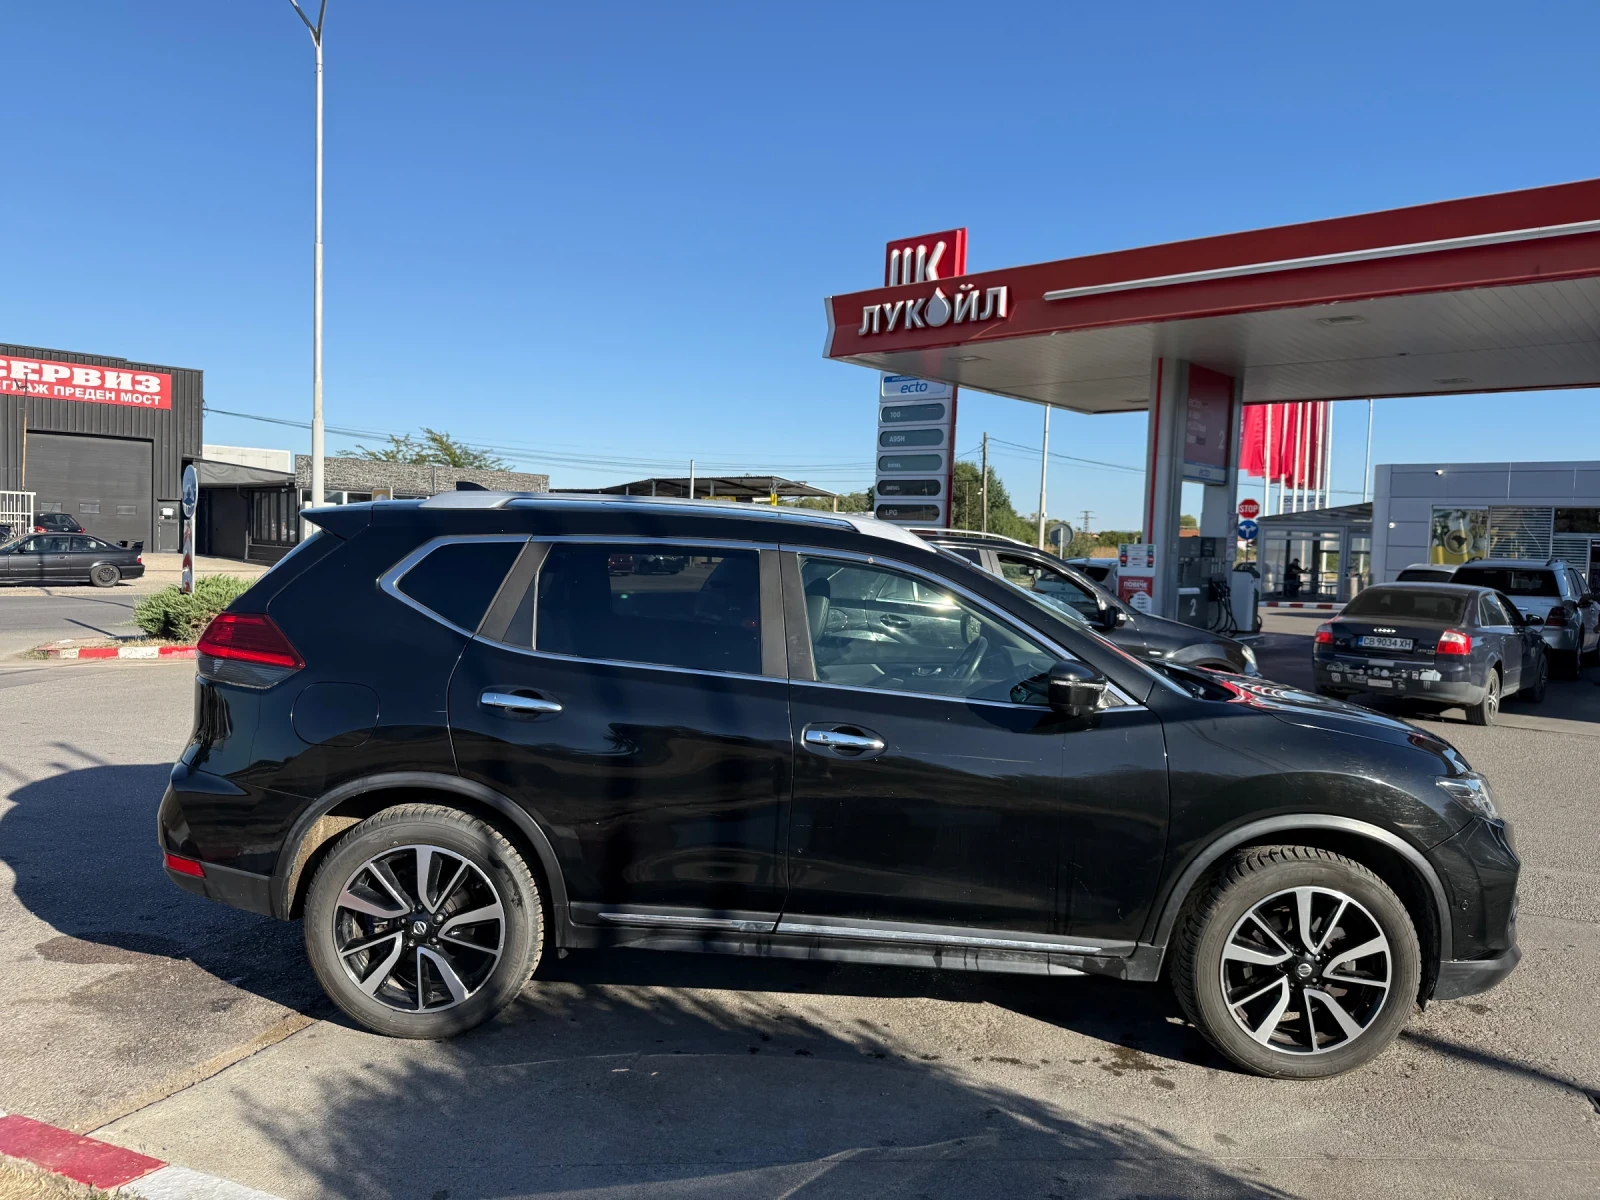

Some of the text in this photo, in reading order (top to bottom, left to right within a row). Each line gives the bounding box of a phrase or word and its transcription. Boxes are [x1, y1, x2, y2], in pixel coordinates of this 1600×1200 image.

[858, 283, 1008, 336] ЛУКОЙЛ
[54, 385, 116, 401] ПРЕДЕН
[120, 392, 161, 405] МОСТ
[900, 381, 928, 394] ecto
[1218, 430, 1225, 449] 2
[1238, 505, 1258, 513] STOP
[1189, 598, 1197, 617] 2
[1363, 637, 1412, 649] CB 9034 XH
